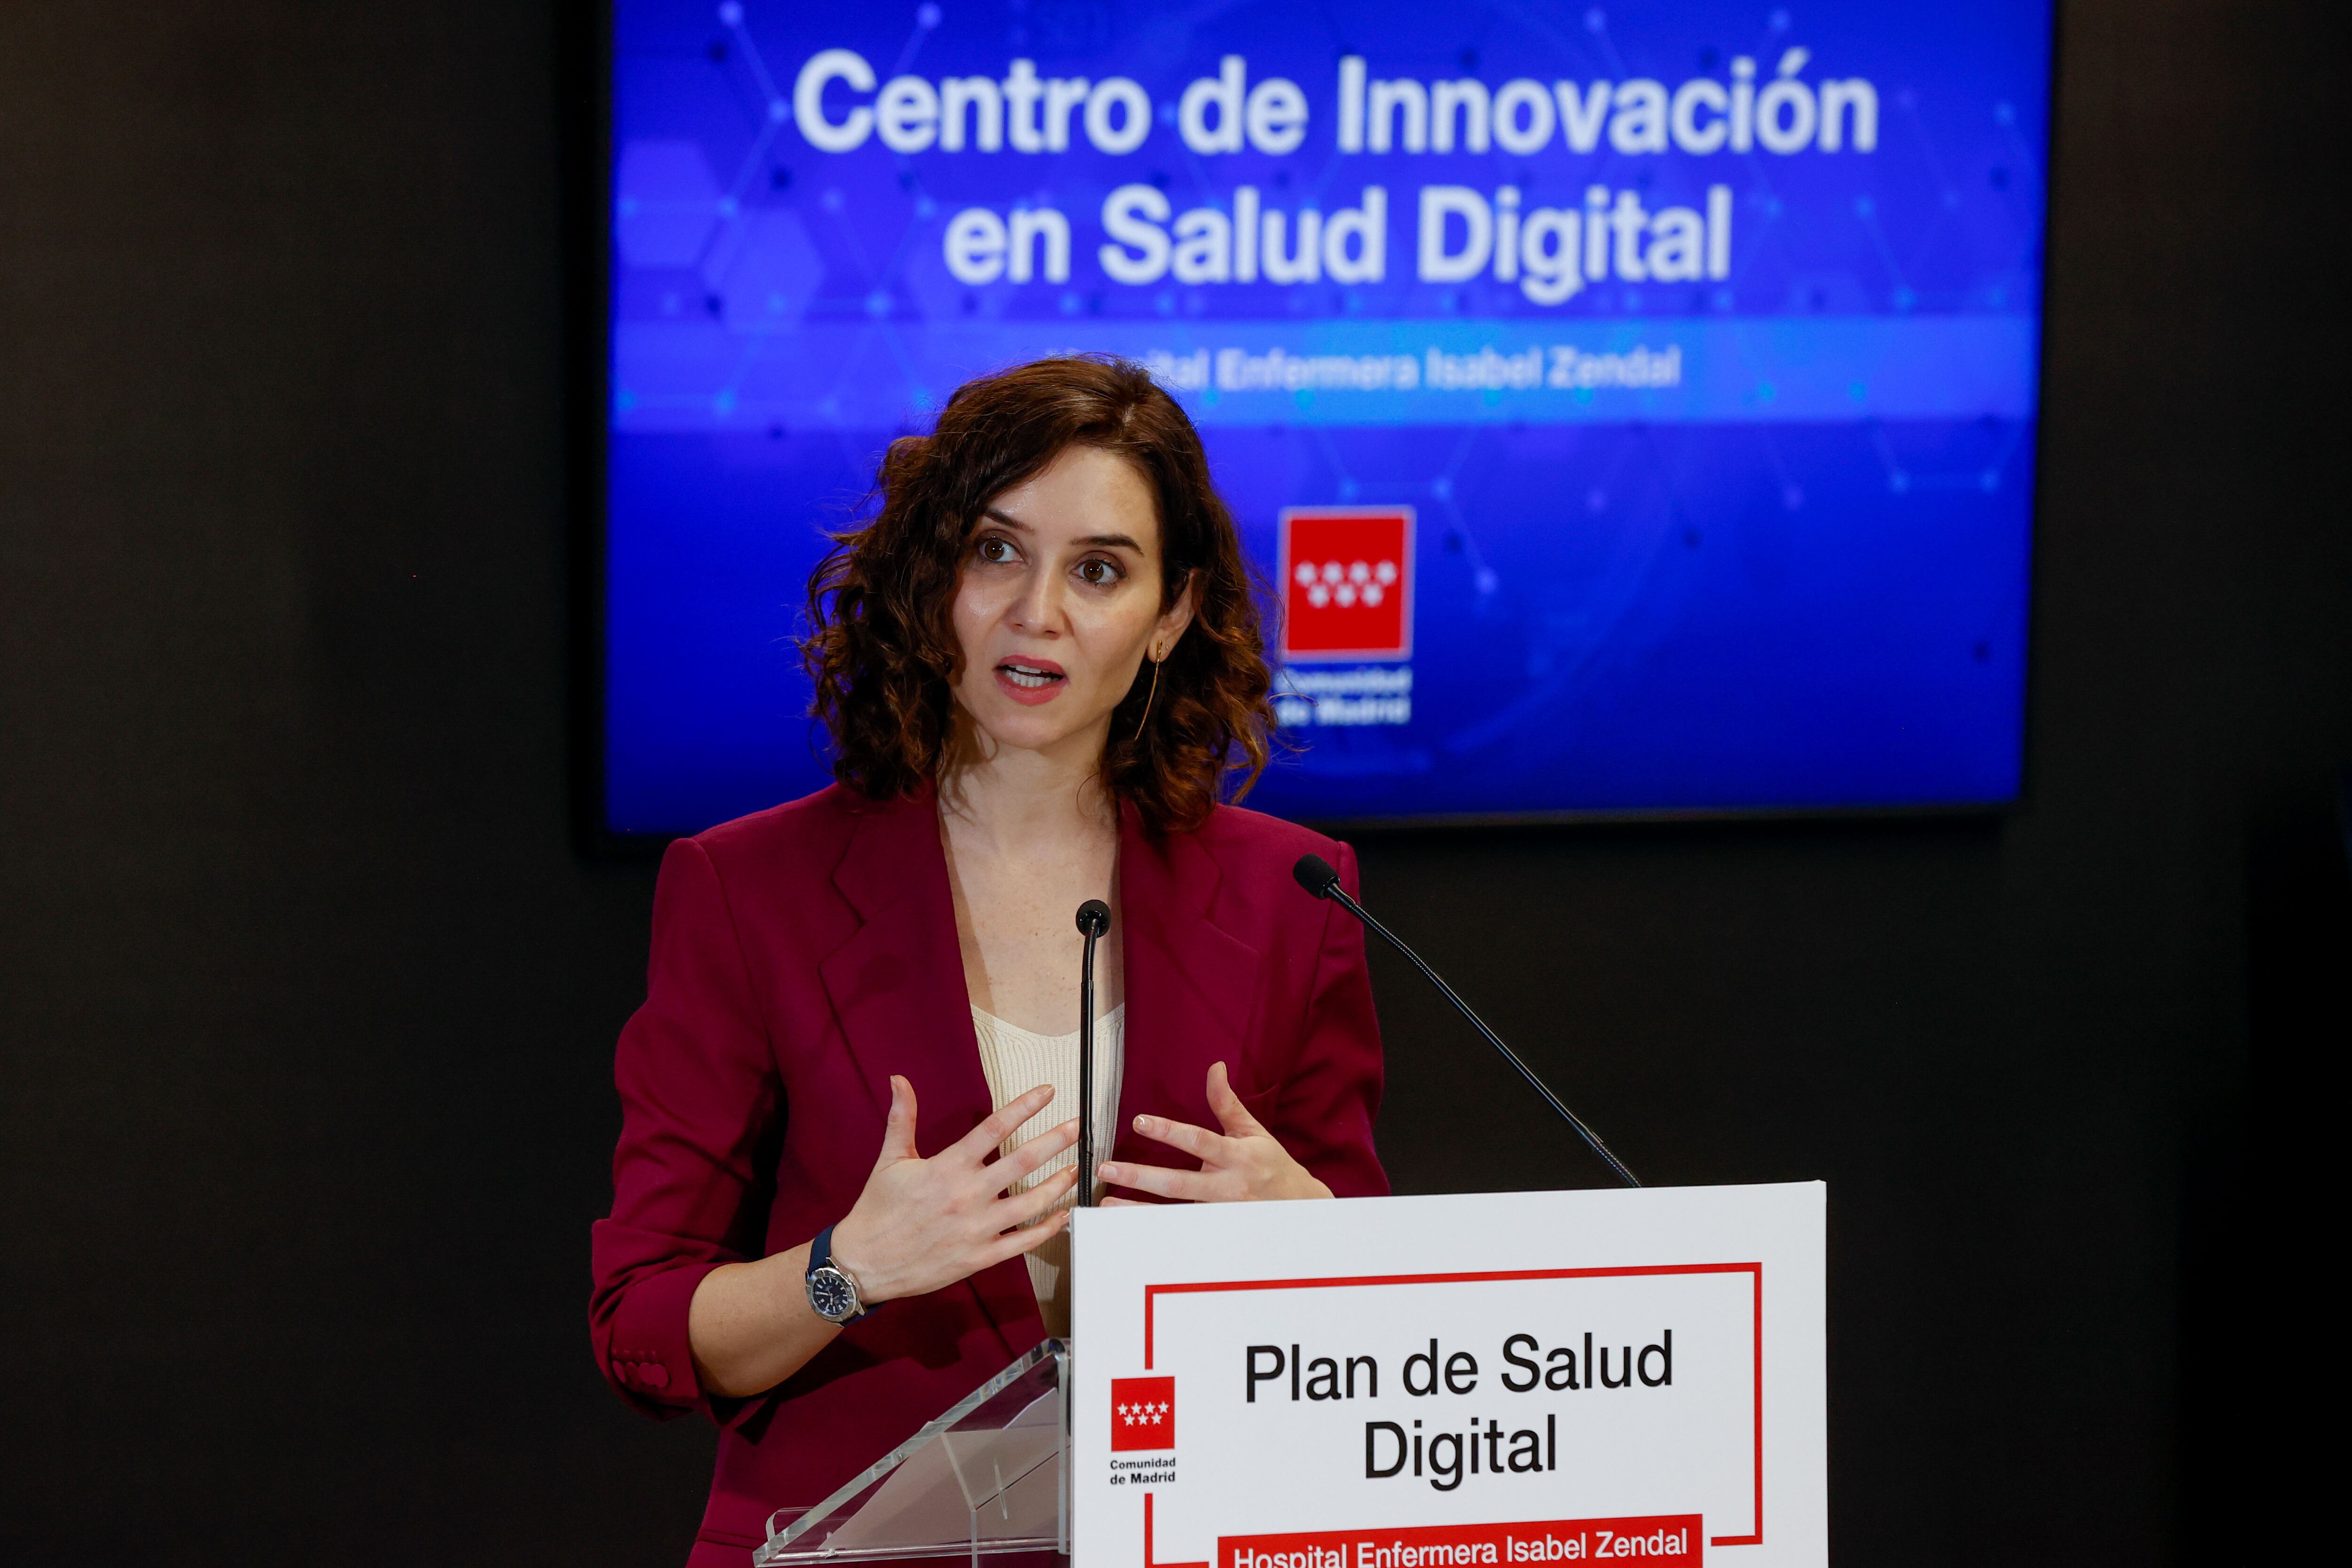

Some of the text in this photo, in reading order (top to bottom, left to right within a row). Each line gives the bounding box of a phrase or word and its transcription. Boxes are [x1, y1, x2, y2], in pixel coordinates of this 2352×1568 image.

[793, 48, 1878, 155] Centro de Innovación
[942, 184, 1733, 306] en Salud Digital
[1216, 347, 1419, 390] Enfermera
[1426, 347, 1542, 388] Isabel
[1549, 345, 1681, 388] Zendal
[1246, 1329, 1672, 1403] Plan de Salud
[1110, 1457, 1176, 1470] Comunidad
[1110, 1472, 1175, 1485] de Madrid
[1365, 1414, 1556, 1492] Digital
[1234, 1528, 1687, 1568] Hospital Enfermera Isabel Zendal
